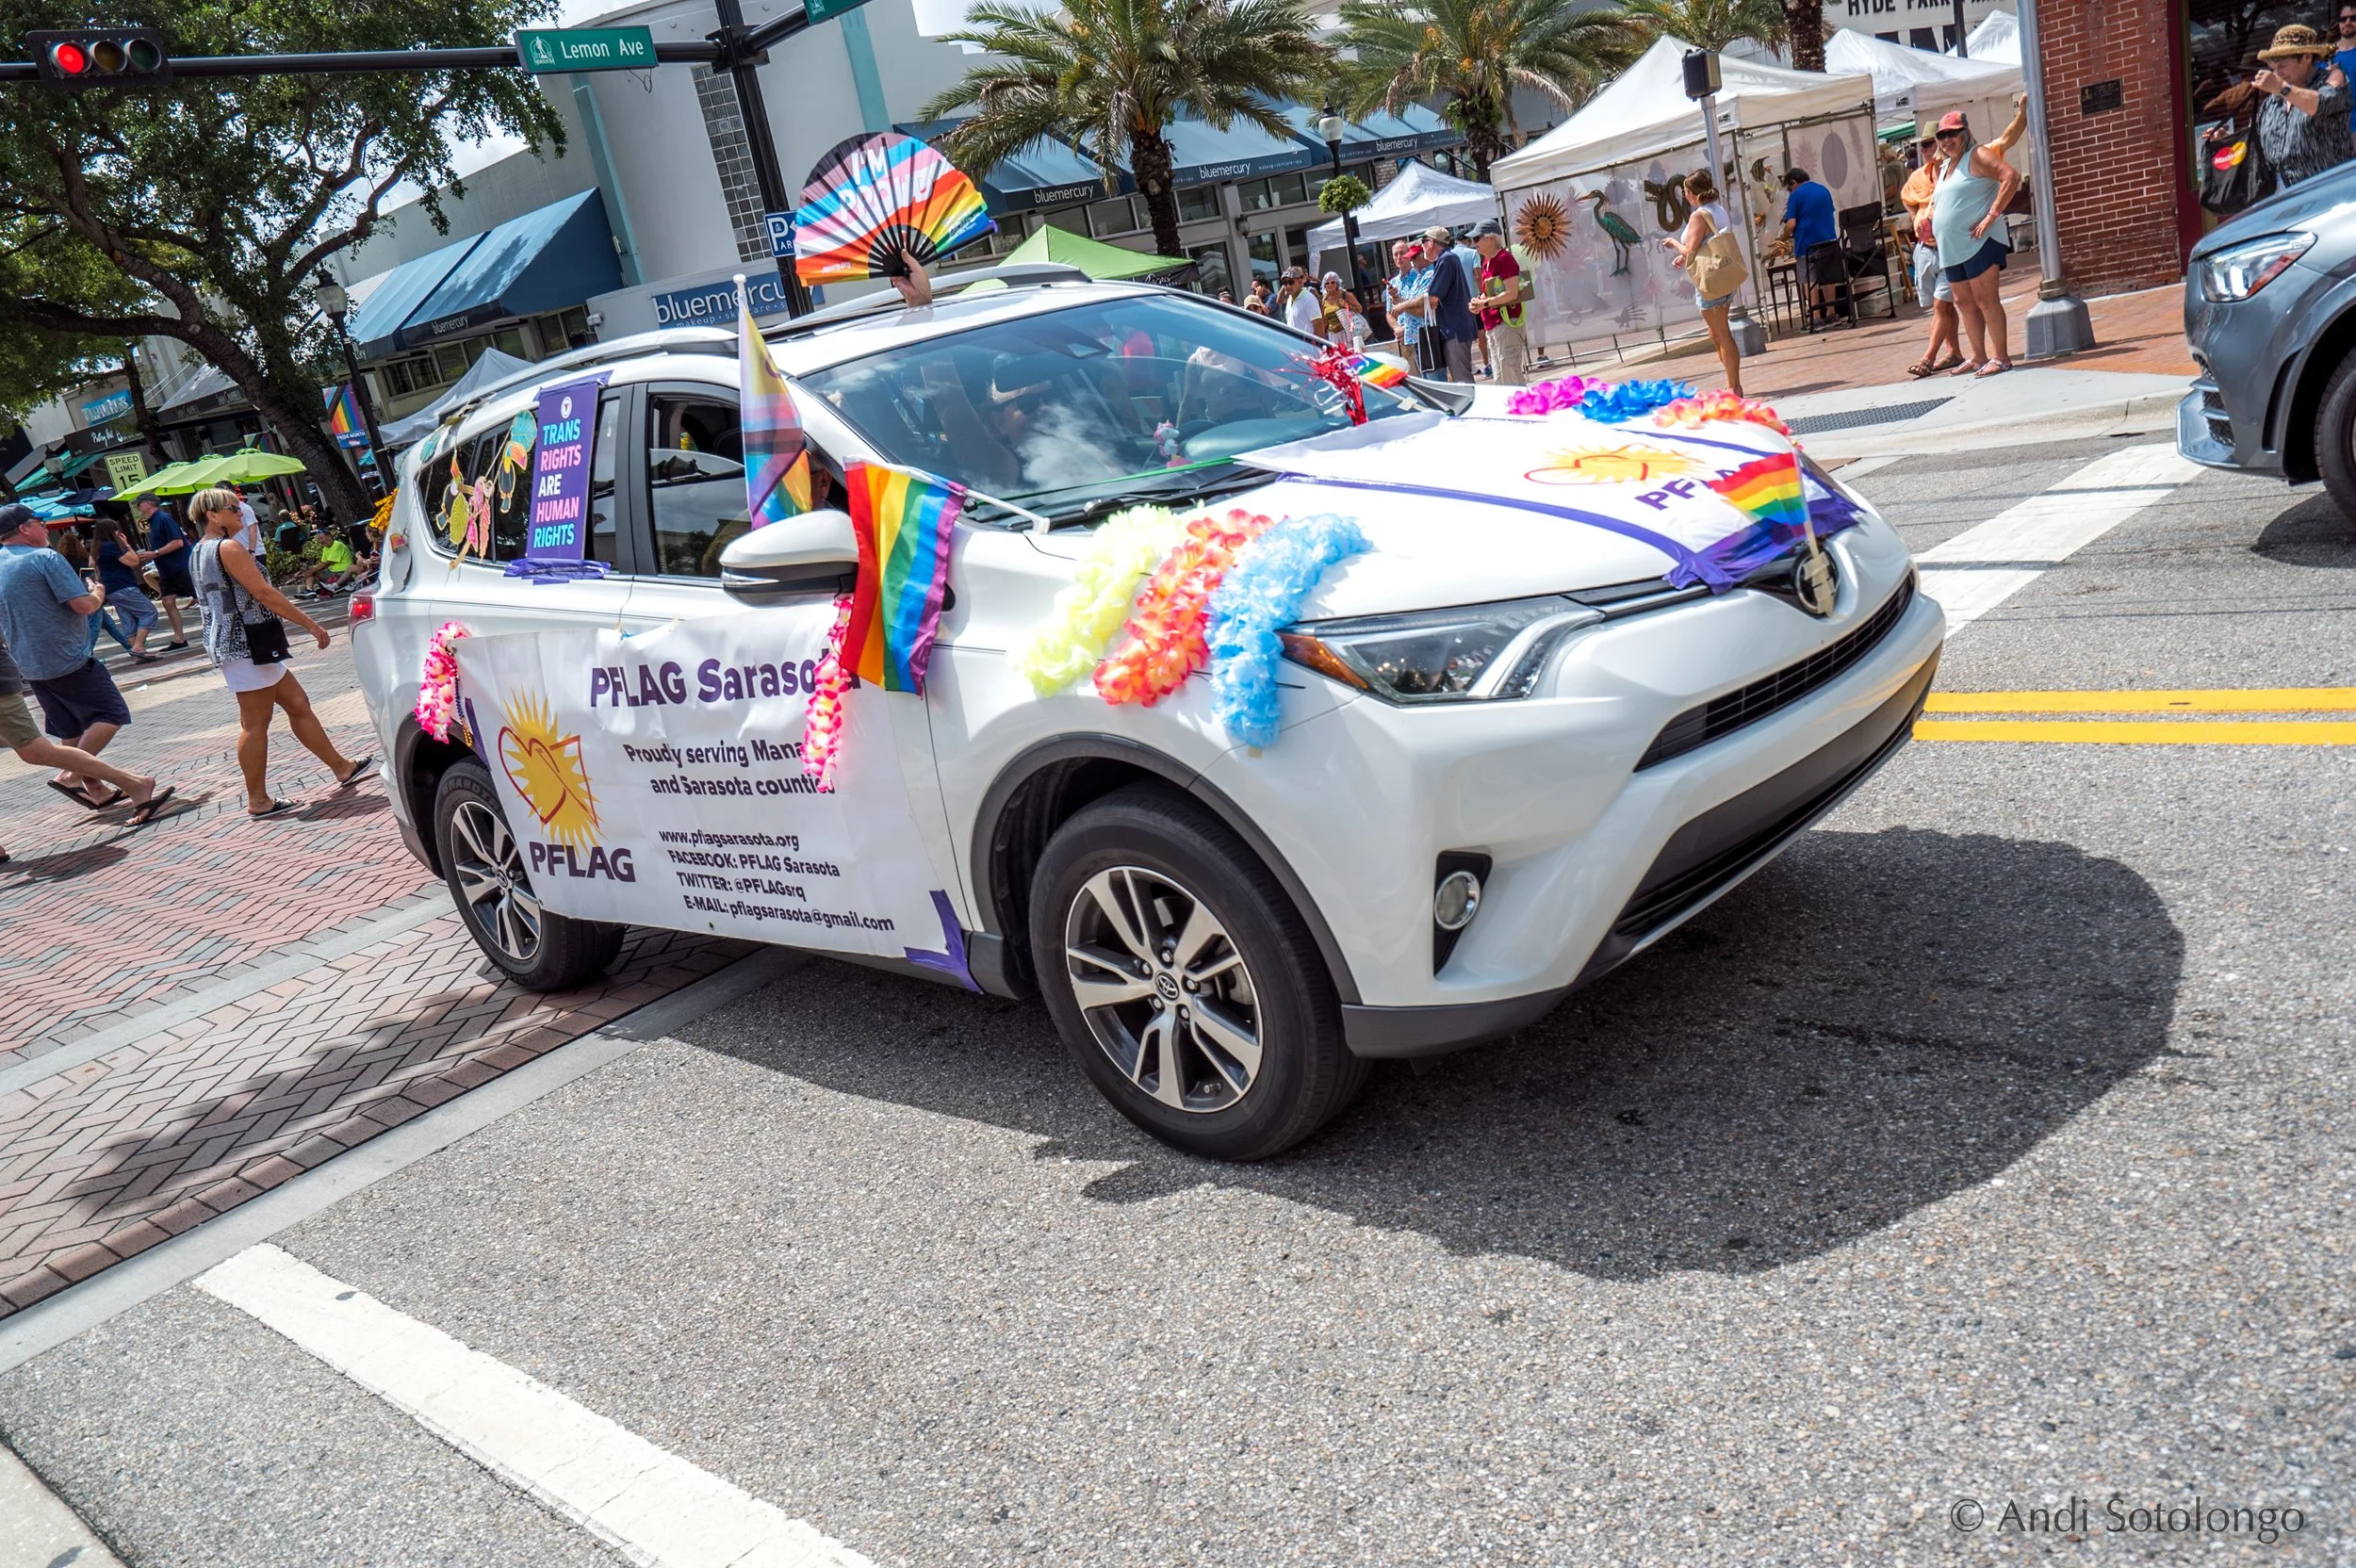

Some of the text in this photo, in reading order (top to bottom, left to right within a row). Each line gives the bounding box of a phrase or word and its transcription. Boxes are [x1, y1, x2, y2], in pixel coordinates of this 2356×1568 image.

[560, 41, 611, 59] Lemon
[619, 38, 645, 57] Ave
[1376, 137, 1418, 152] bluemercury
[851, 145, 891, 186] I'M
[1199, 162, 1252, 180] bluemercury
[1034, 184, 1094, 204] bluemercury
[652, 281, 813, 323] bluemercu
[432, 315, 469, 335] bluemercury
[676, 317, 715, 329] makeup
[725, 304, 771, 319] skare
[543, 418, 581, 446] TRANS
[108, 455, 139, 466] SPEED
[114, 464, 138, 473] LIMIT
[540, 445, 581, 471] RIGHTS
[119, 473, 141, 490] 15
[538, 473, 563, 498] ARE
[535, 497, 580, 523] HUMAN
[533, 523, 575, 548] RIGHTS
[591, 648, 860, 707] PFLAG Saraso
[623, 740, 803, 769] Proudly serving Mana
[650, 773, 835, 796] and Sarasota counti
[659, 828, 799, 852] www.pflagsarasota.org
[529, 841, 636, 883] PFLAG
[667, 849, 841, 877] FACEBOOK: PFLAG Sarasota
[676, 871, 807, 902] TWITTER: @PFLAGsrq
[683, 894, 895, 931] E-MAIL: pflagsarasota@gmail.com
